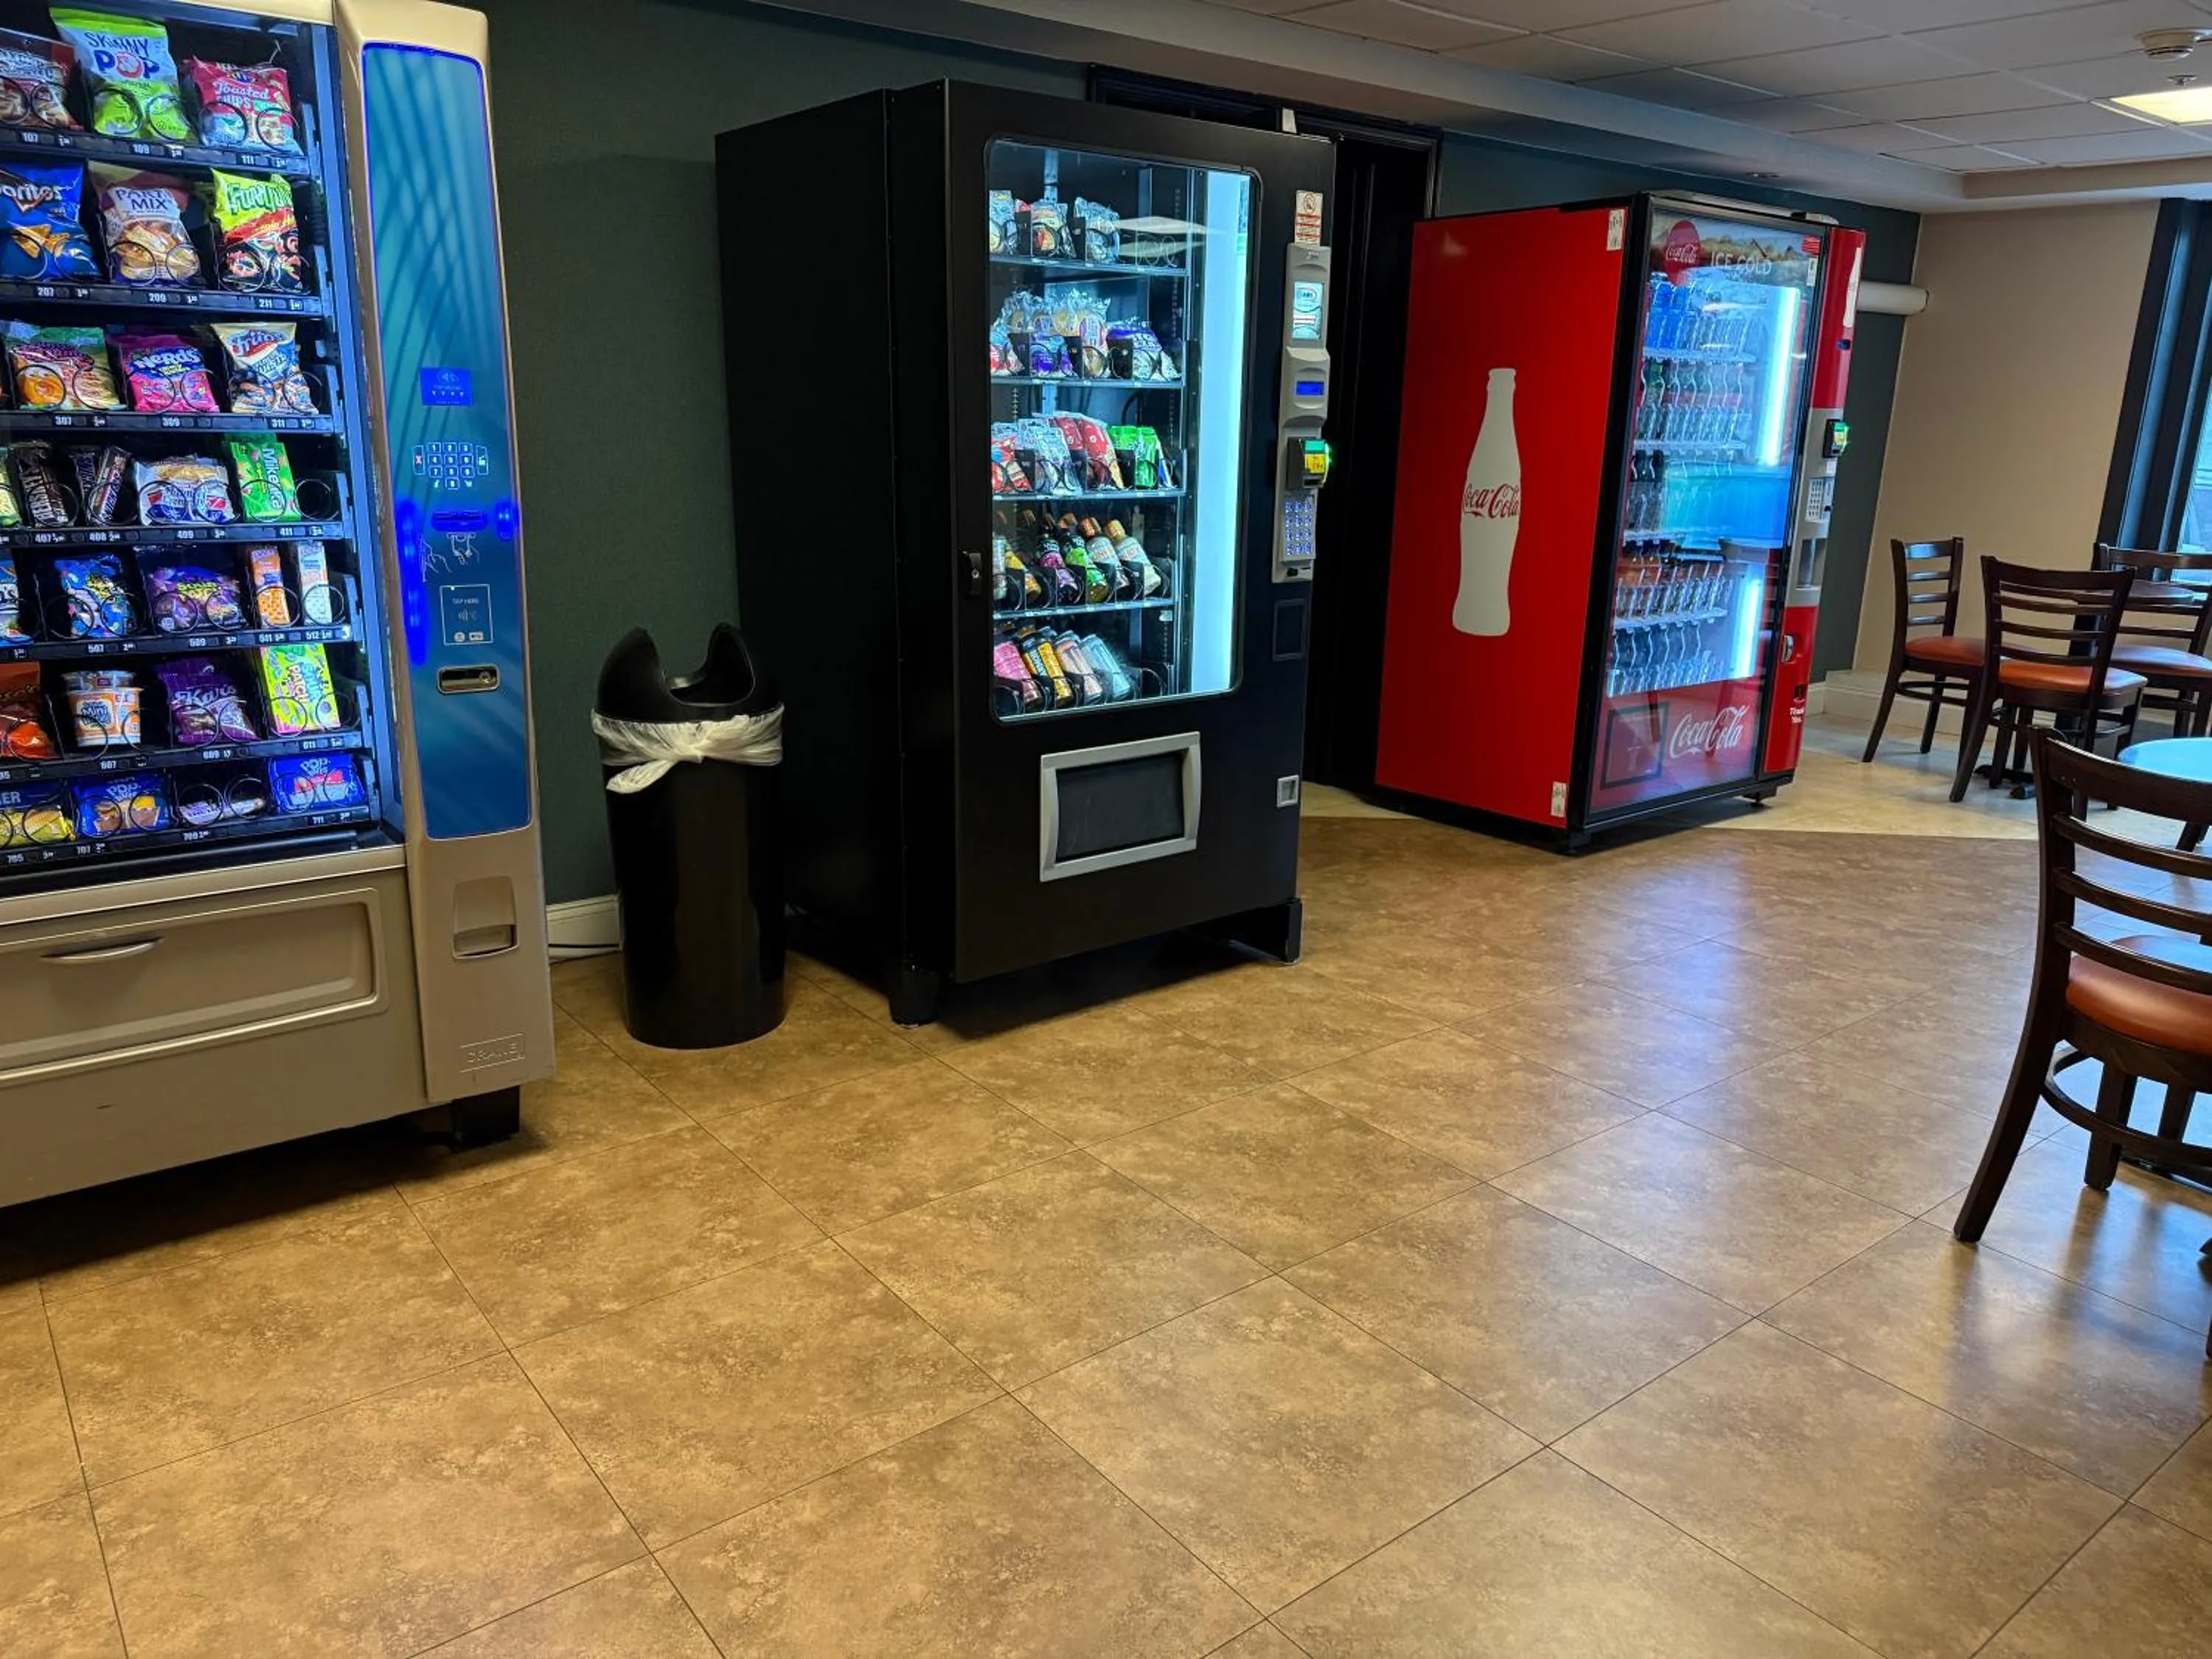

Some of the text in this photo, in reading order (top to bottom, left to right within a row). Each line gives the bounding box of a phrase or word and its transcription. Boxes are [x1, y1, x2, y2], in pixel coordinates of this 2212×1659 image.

[0, 184, 63, 201] oritos
[131, 198, 169, 211] MIX
[1711, 250, 1772, 275] ICE COLD
[1669, 704, 1751, 759] Coca-Cola
